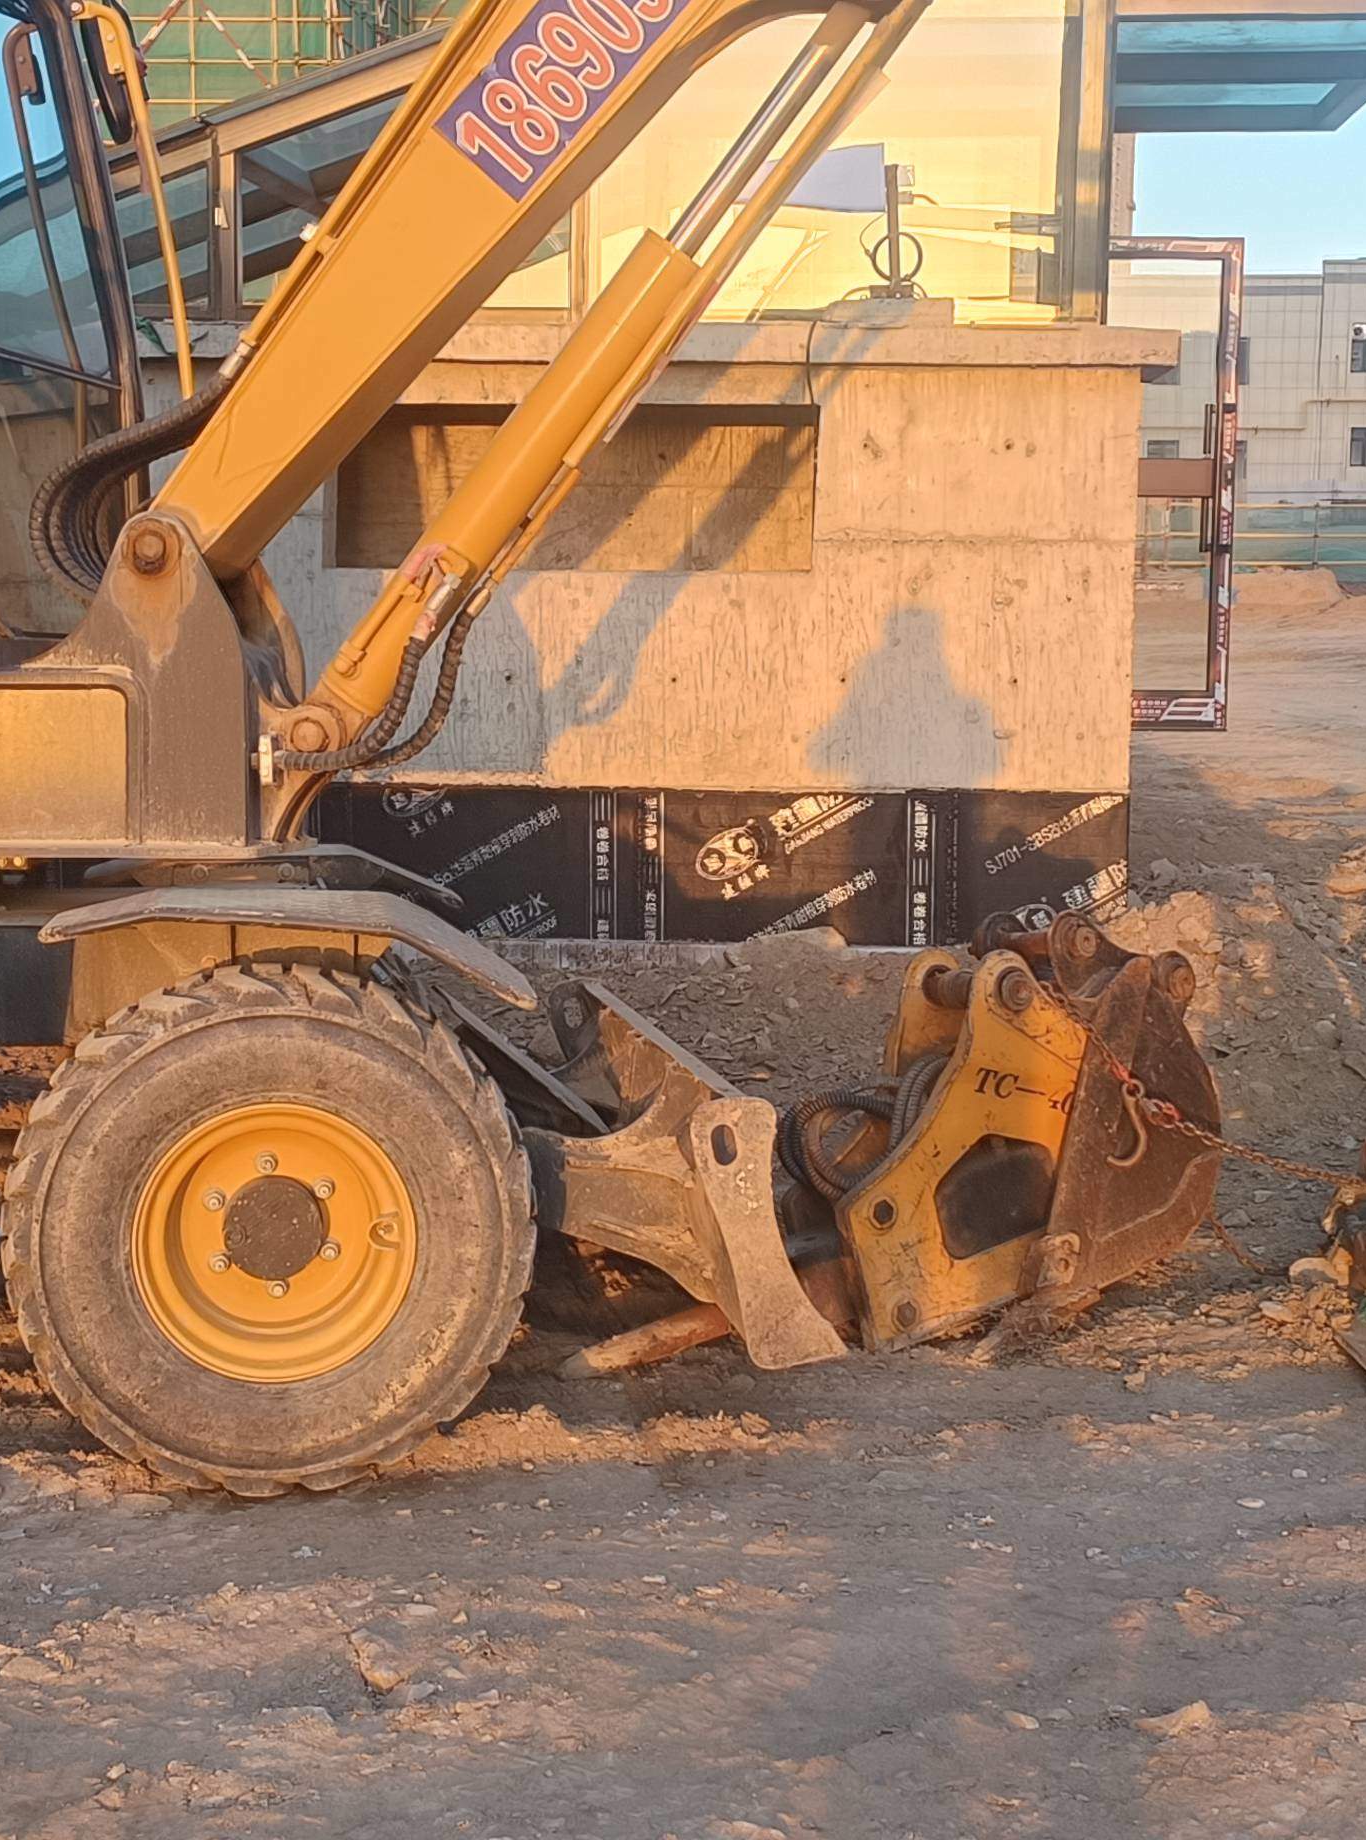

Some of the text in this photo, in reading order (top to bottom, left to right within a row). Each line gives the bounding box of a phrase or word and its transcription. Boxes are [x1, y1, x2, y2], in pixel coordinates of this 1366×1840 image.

[455, 0, 673, 183] 18690
[430, 803, 562, 888] S改性沥青耐根穿刺防水卷材
